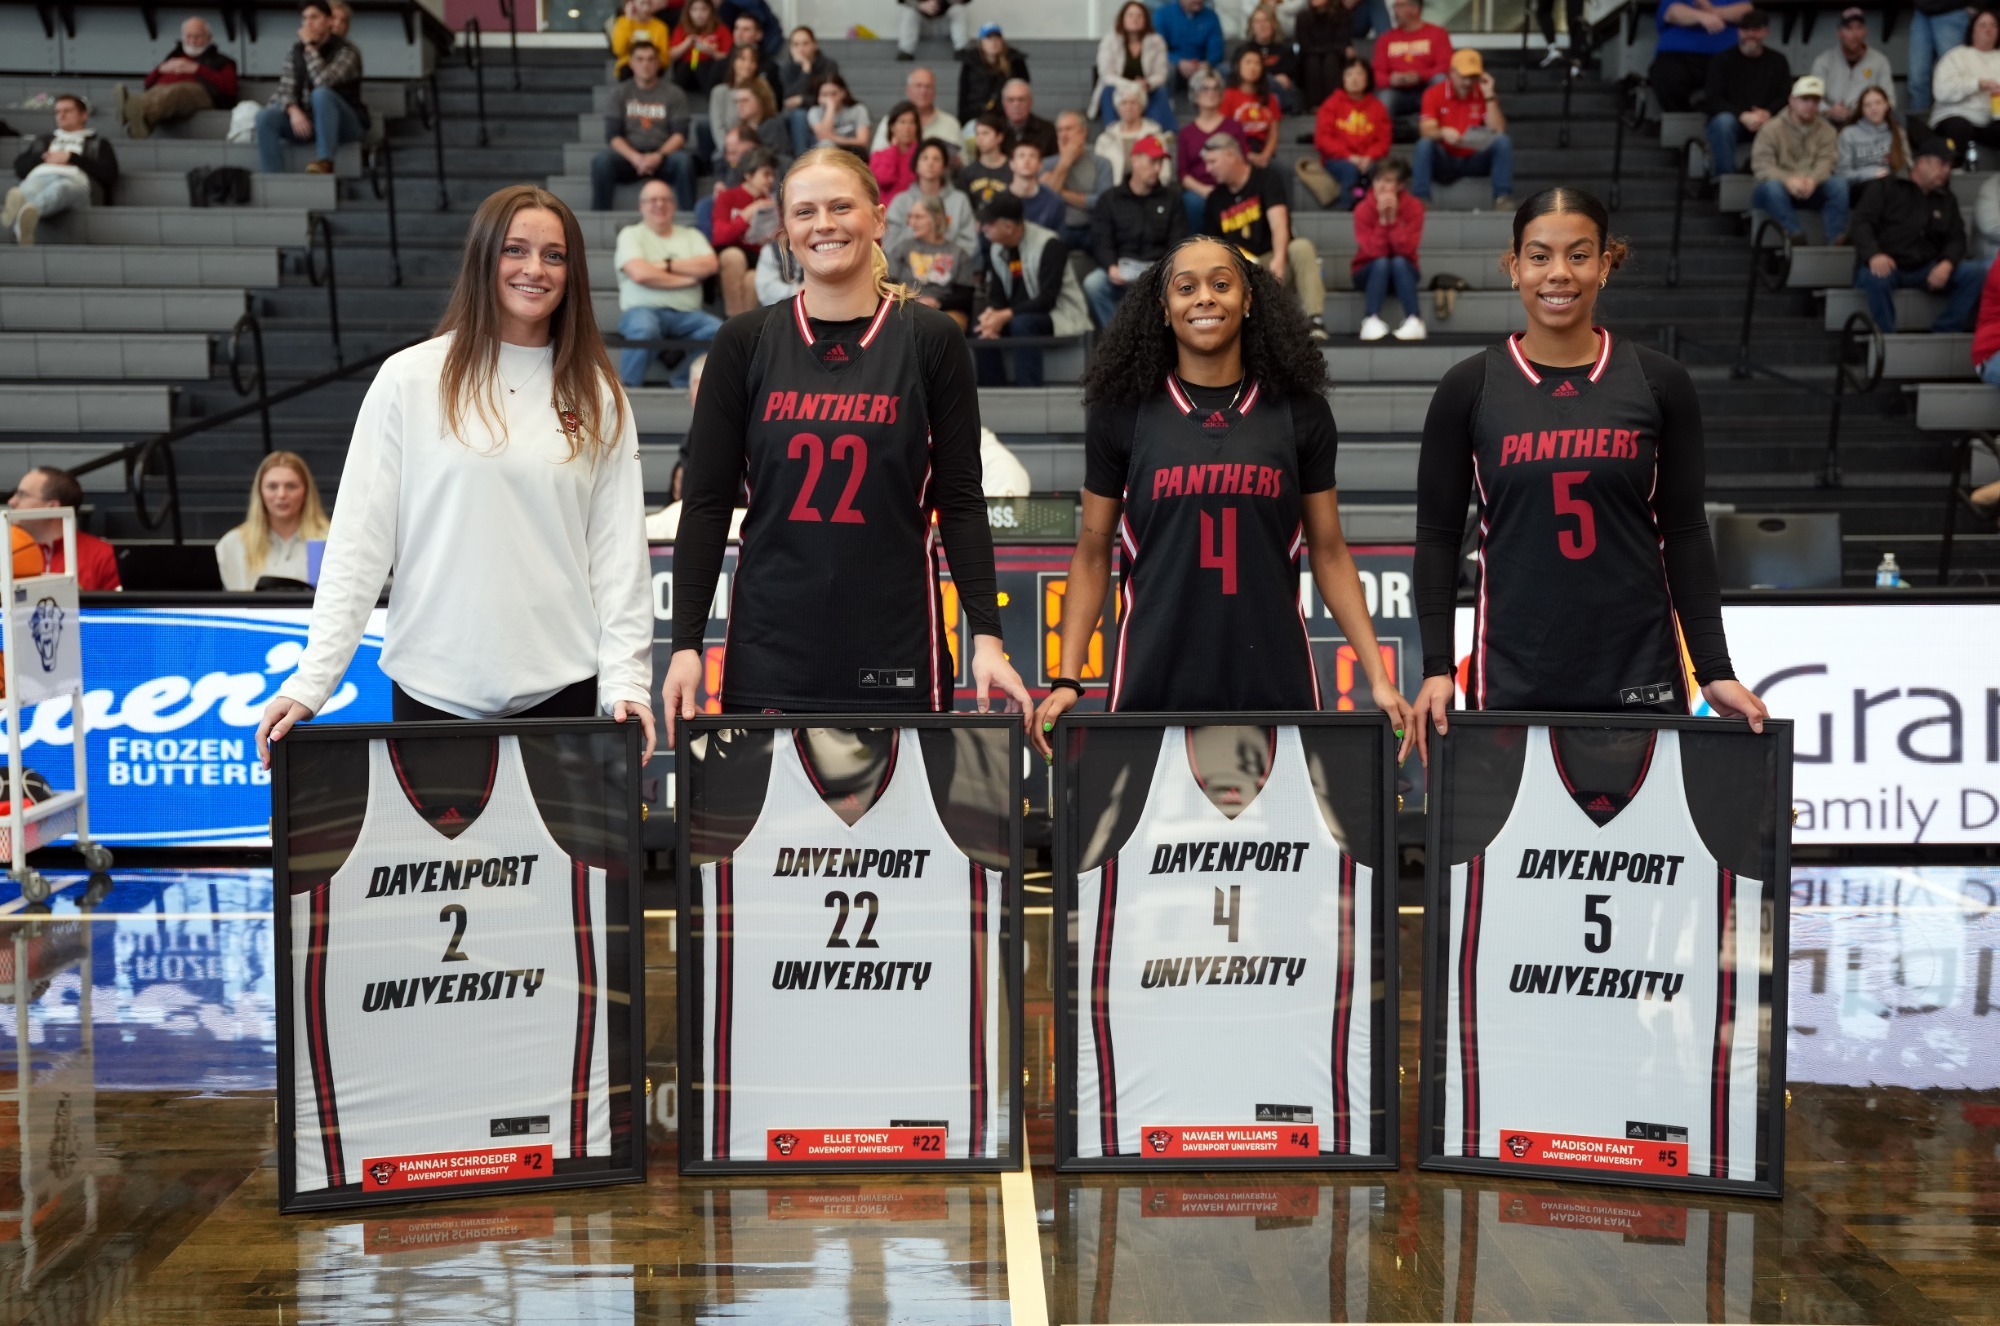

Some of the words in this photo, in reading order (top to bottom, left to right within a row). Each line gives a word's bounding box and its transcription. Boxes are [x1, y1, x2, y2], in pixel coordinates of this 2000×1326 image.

[762, 390, 901, 424] PANTHERS
[1552, 389, 1579, 397] adidas
[1499, 428, 1641, 467] PANTHERS
[787, 432, 867, 524] 22
[1151, 463, 1283, 500] PANTHERS
[1552, 470, 1597, 560] 5
[1200, 507, 1237, 595] 4
[1751, 663, 2000, 764] Gra
[108, 737, 243, 761] FROZEN
[108, 762, 271, 786] BUTTERB
[1791, 784, 1939, 843] amily
[773, 847, 931, 878] DAVENPORT
[1148, 841, 1310, 875] DAVENPORT
[1516, 848, 1685, 886] DAVENPORT
[365, 854, 539, 899] DAVENPORT
[824, 890, 880, 948] 22
[1213, 885, 1241, 943] 4
[1584, 894, 1612, 954] 5
[439, 903, 469, 963] 2
[771, 960, 932, 990] UNIVERSITY
[1140, 955, 1307, 989] UNIVERSITY
[1508, 964, 1684, 1002] UNIVERSITY
[362, 968, 545, 1012] UNIVERSITY
[808, 1146, 855, 1154] DAVENPORT
[857, 1145, 904, 1154] UNIVERSITY
[823, 1134, 852, 1144] ELLIE
[854, 1133, 889, 1144] TONEY
[912, 1135, 941, 1151] #22
[1182, 1131, 1224, 1141] NAVAEH
[1225, 1130, 1278, 1141] WILLIAMS
[1182, 1143, 1229, 1151] DAVENPORT
[1231, 1142, 1278, 1151] UNIVERSITY
[1290, 1132, 1309, 1149] #4
[1551, 1139, 1603, 1153] MADISON
[1605, 1143, 1635, 1155] FANT
[399, 1158, 448, 1172] HANNAH
[450, 1153, 517, 1167] SCHROEDER
[407, 1171, 458, 1182] DAVENPORT
[459, 1166, 509, 1177] UNIVERSITY
[523, 1152, 543, 1170] #2
[1542, 1150, 1592, 1162] DAVENPORT
[1593, 1155, 1643, 1166] UNIVERSITY
[1658, 1150, 1678, 1167] #5
